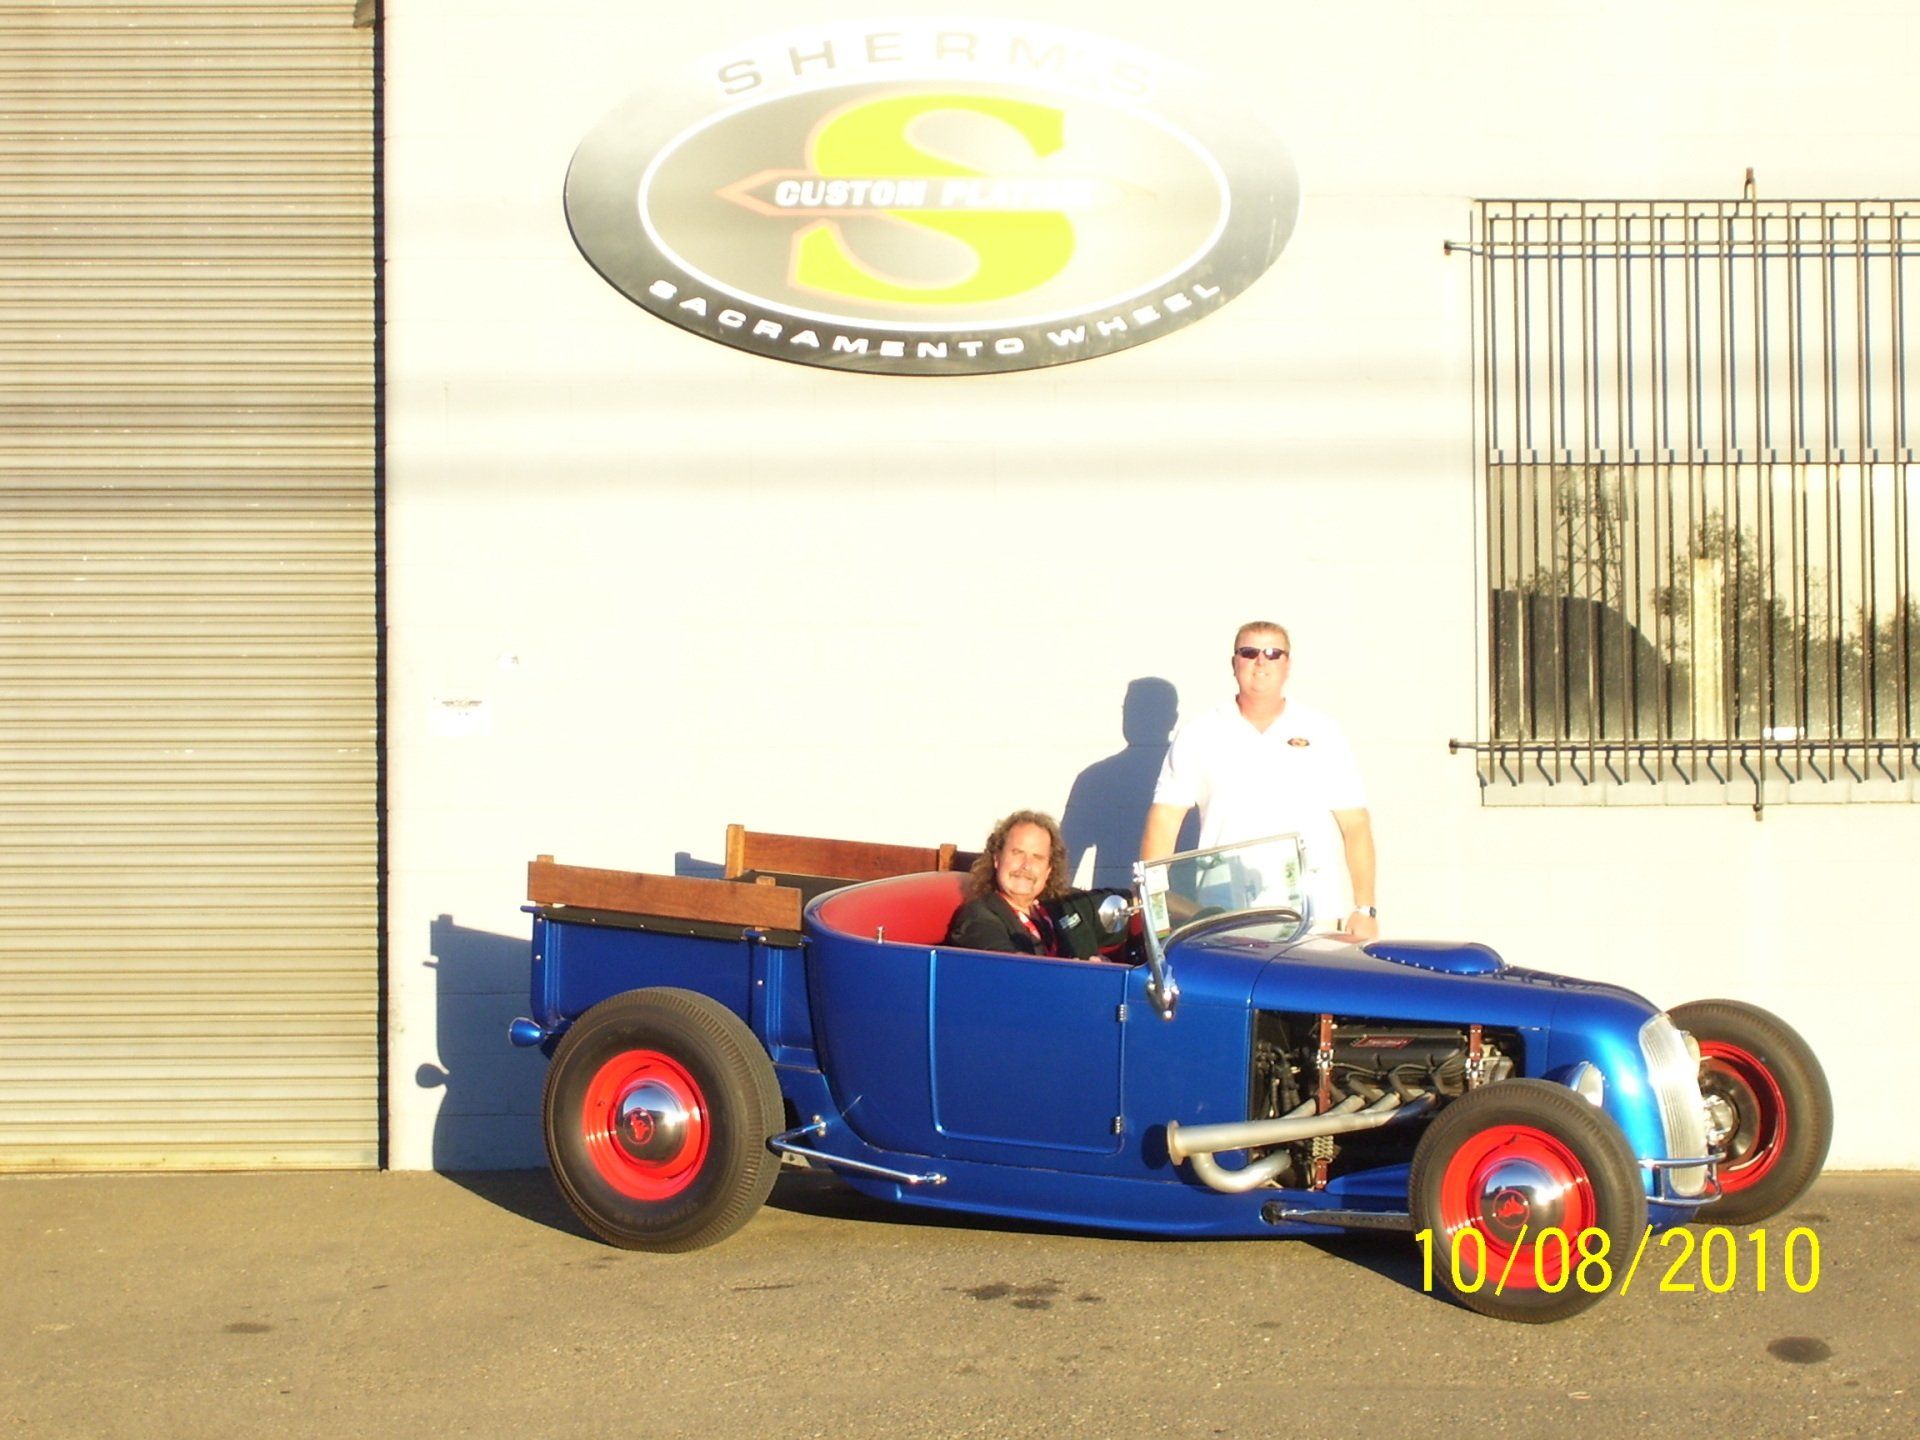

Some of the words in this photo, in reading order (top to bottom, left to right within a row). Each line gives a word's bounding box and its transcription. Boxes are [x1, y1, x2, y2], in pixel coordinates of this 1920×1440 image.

[775, 179, 928, 208] CUSTOM
[941, 179, 1093, 208] PLAT
[648, 279, 1025, 358] SACRAMENTO
[1047, 283, 1221, 347] WHEEL
